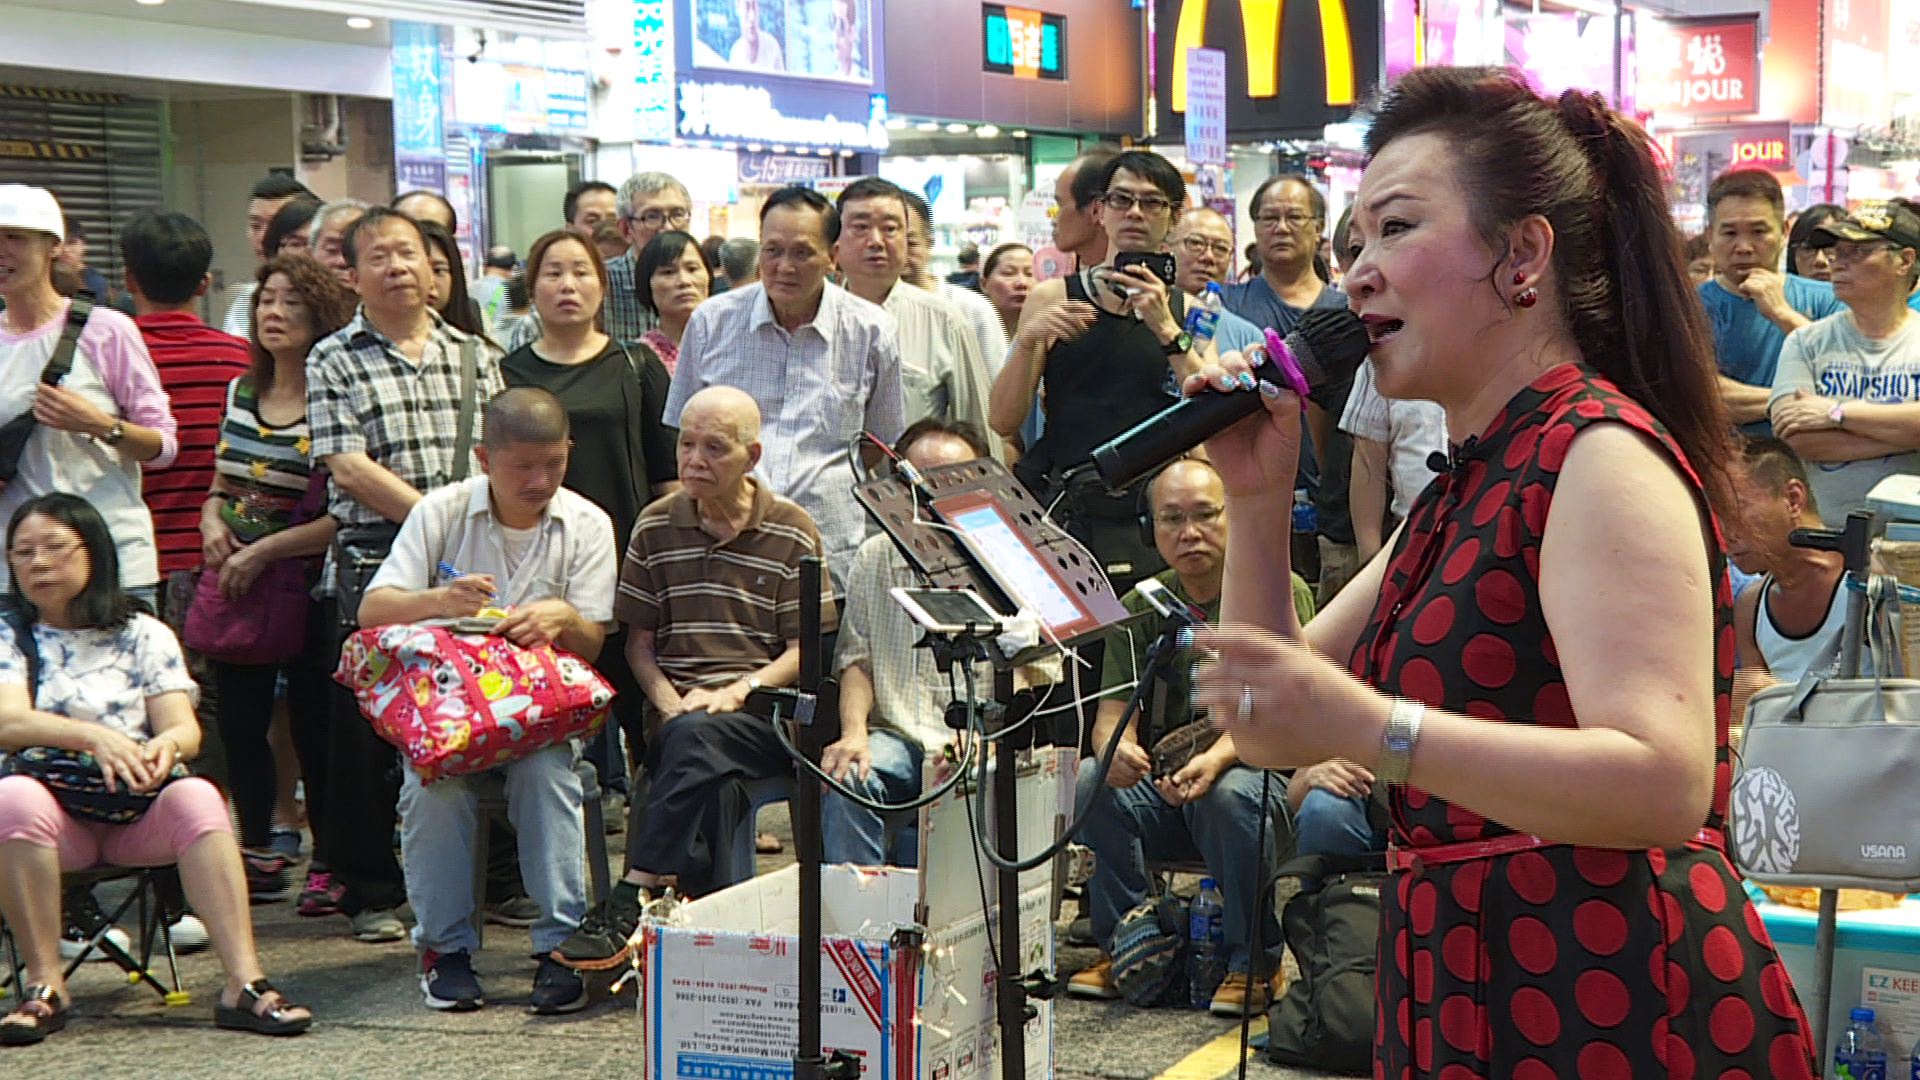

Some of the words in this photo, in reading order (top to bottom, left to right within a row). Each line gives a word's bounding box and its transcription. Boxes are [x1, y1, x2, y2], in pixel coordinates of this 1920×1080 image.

[1731, 141, 1785, 164] JOUR
[1821, 370, 1920, 402] SNAPSHOT
[1861, 844, 1906, 859] USANA
[1869, 974, 1889, 988] EZ
[720, 1045, 739, 1053] Kee
[741, 1046, 769, 1056] Moon
